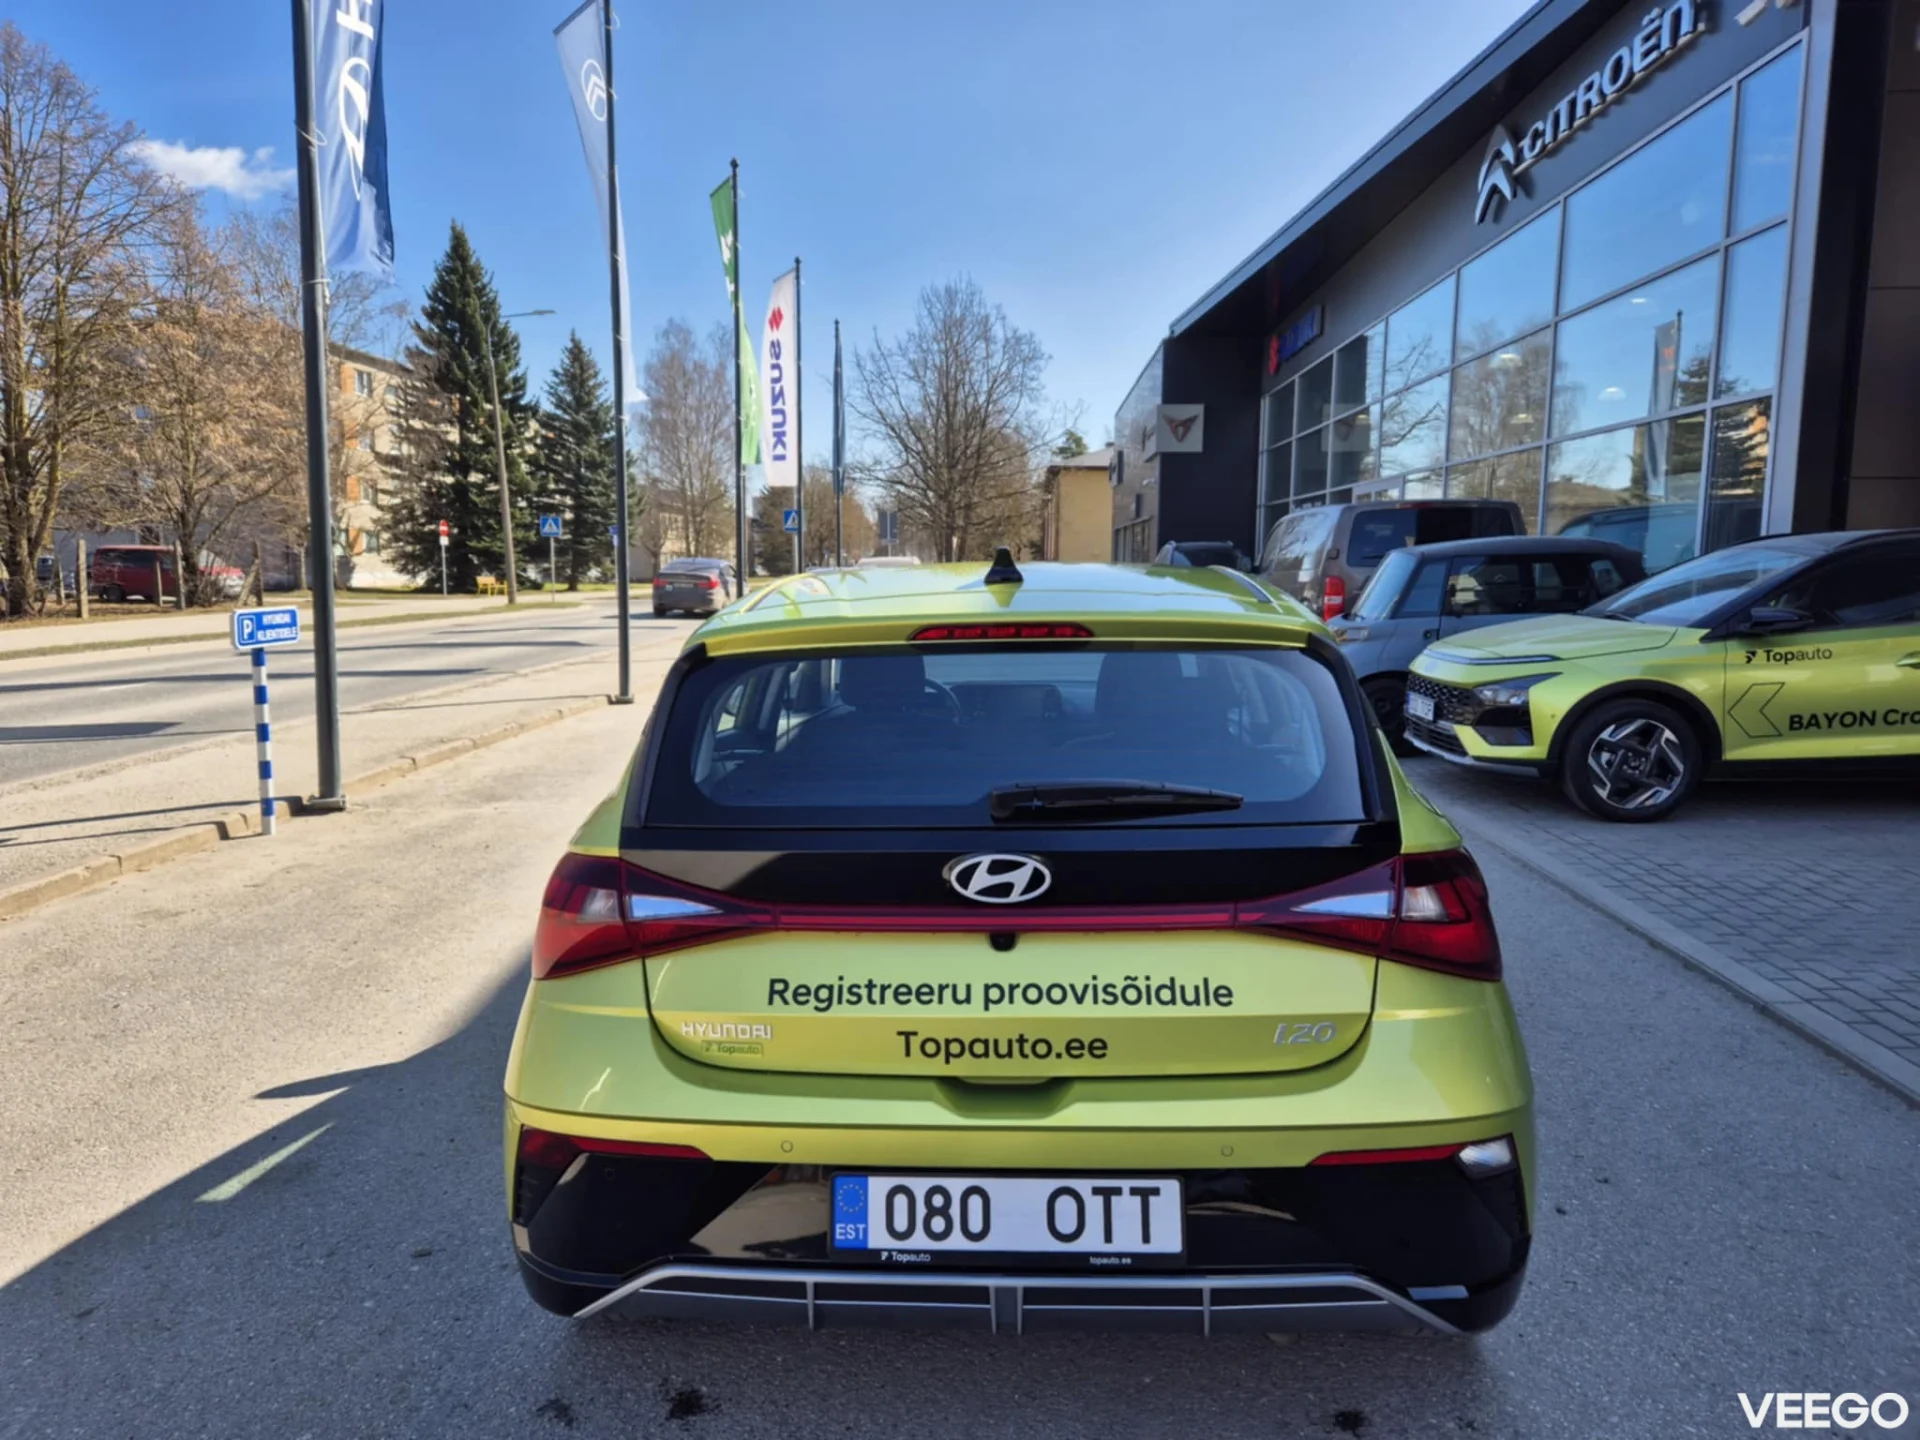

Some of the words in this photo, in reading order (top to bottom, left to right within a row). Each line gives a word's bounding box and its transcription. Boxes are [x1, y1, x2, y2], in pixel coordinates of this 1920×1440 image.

[1763, 648, 1833, 664] Topauto
[1788, 710, 1877, 731] BAYON
[767, 976, 972, 1012] Registreeru
[983, 975, 1234, 1011] proovisõidule
[681, 1021, 772, 1040] HYUNDAI
[716, 1043, 760, 1055] Topauto
[896, 1031, 1109, 1064] Topauto.ee
[885, 1184, 991, 1243] 080
[1046, 1186, 1161, 1245] OTT
[835, 1223, 867, 1240] EST
[891, 1252, 931, 1263] Topauto
